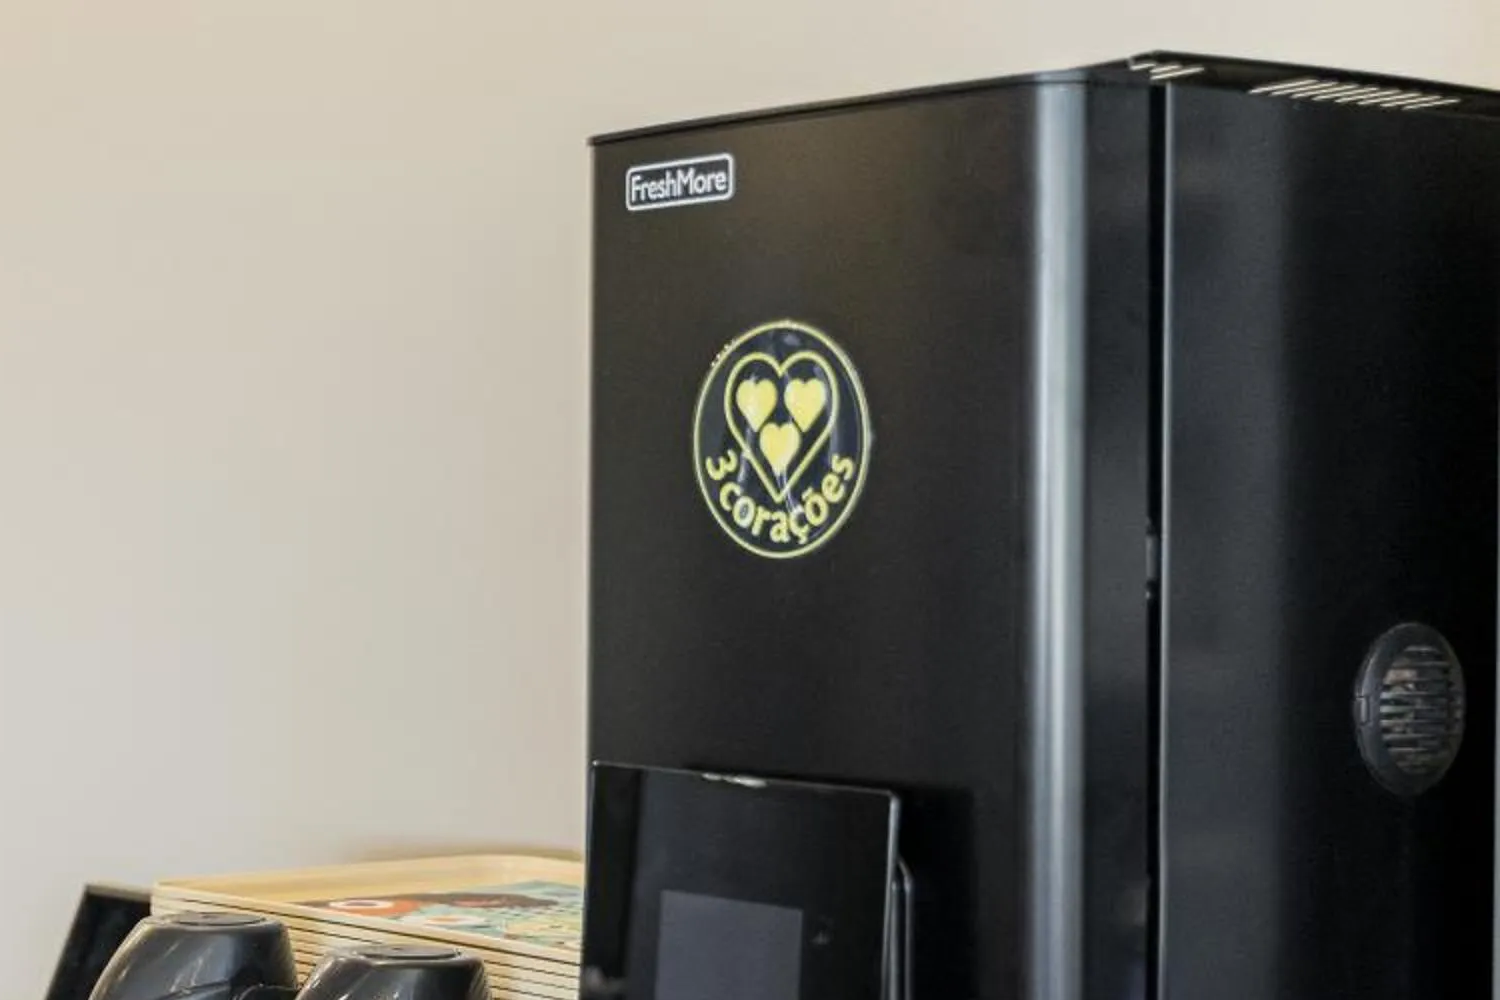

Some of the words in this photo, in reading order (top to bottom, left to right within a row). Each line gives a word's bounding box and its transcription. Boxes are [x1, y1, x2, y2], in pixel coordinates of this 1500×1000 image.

[631, 167, 727, 203] FreshMore
[705, 449, 738, 480] 3
[719, 453, 855, 544] corações
